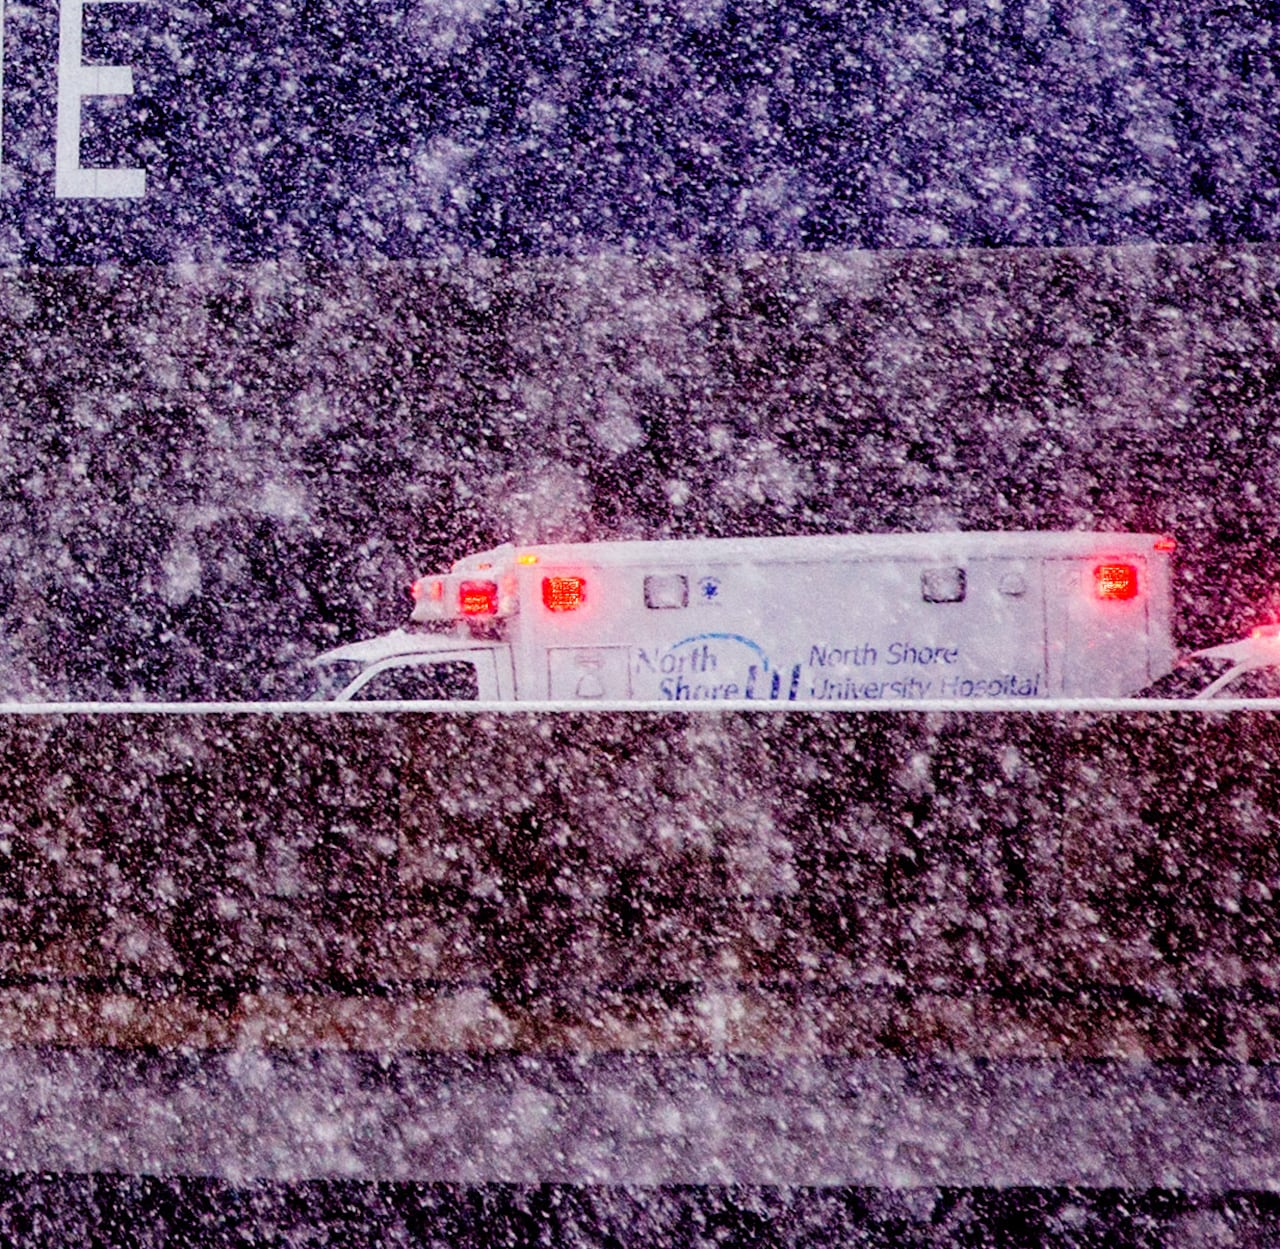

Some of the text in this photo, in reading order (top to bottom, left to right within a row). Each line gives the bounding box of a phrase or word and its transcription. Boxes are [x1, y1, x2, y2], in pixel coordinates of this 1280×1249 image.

[636, 644, 717, 674] North
[808, 641, 959, 667] North Shore
[659, 675, 740, 701] Shore
[810, 672, 1041, 701] University Hospital
